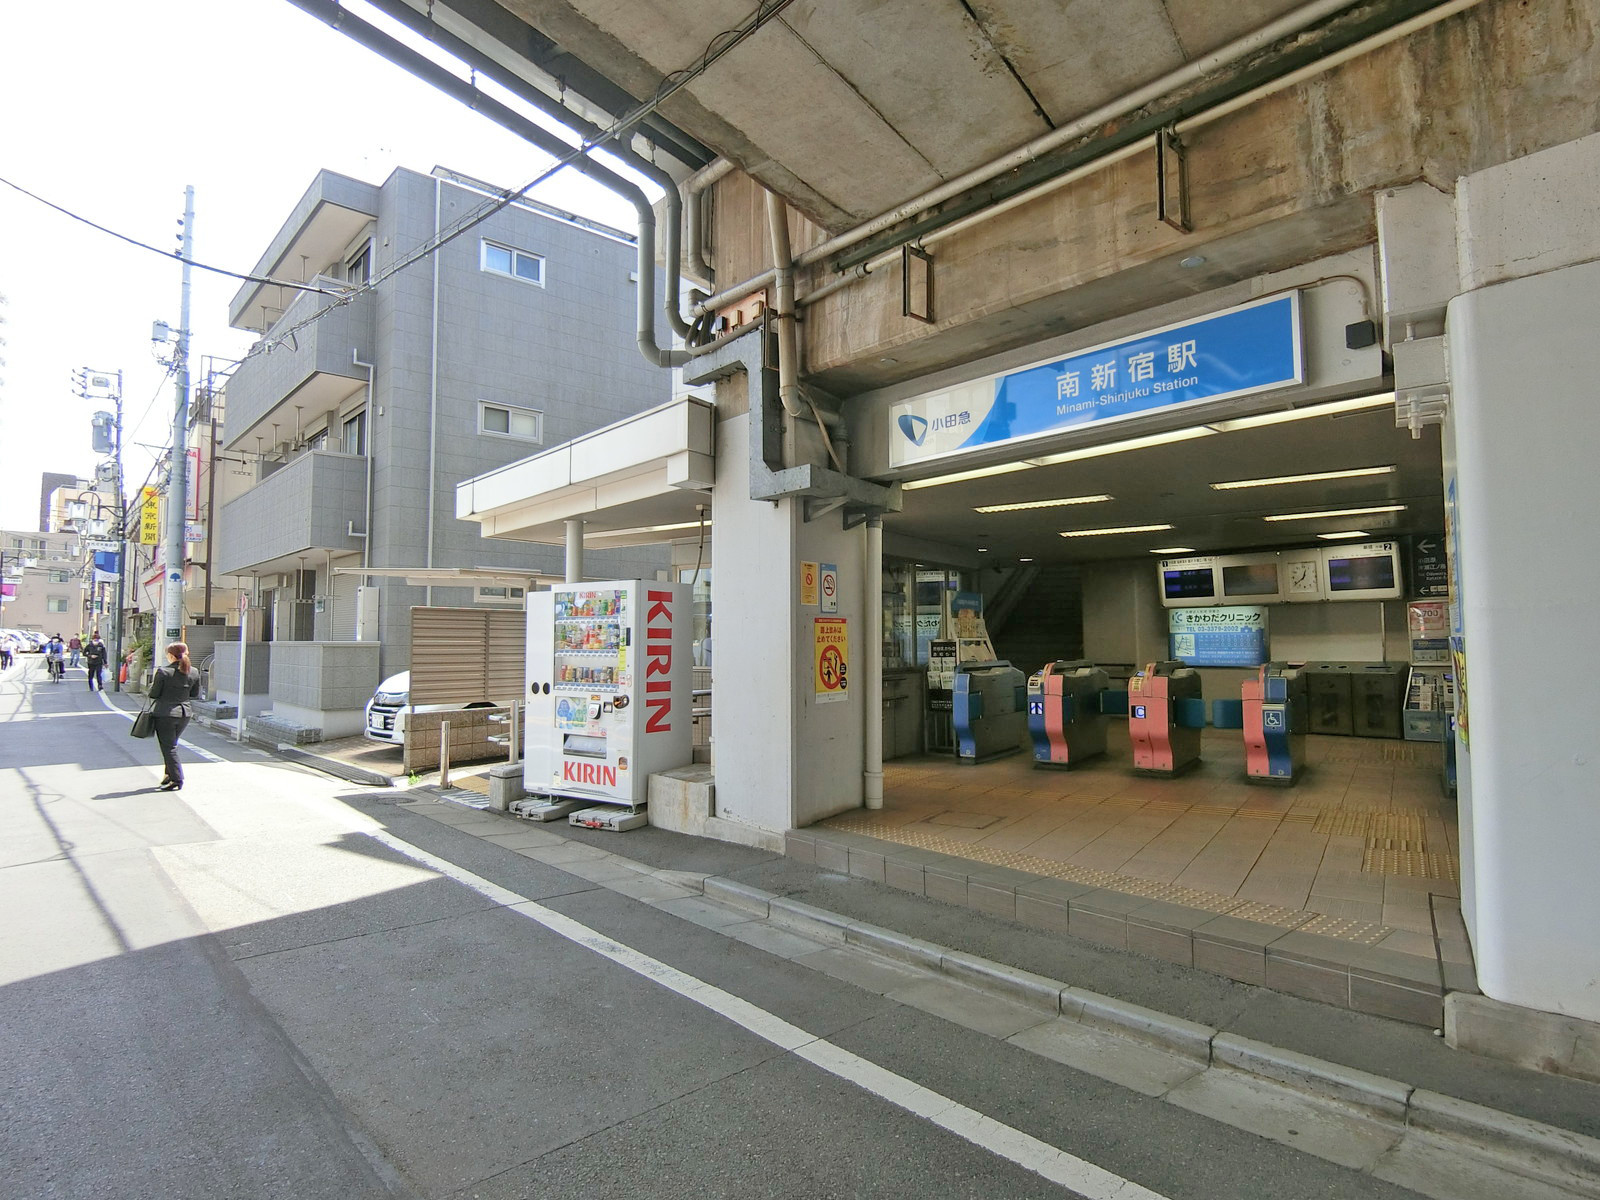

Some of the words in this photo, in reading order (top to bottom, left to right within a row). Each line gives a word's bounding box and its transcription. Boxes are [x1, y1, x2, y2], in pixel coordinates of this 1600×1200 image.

[1056, 339, 1197, 399] 南新宿駅
[1056, 387, 1150, 416] Minami-Shinjuku
[1153, 374, 1199, 394] Station
[931, 409, 972, 432] 小田急
[144, 500, 157, 542] 東京新聞
[1384, 543, 1392, 551] 2
[1186, 612, 1262, 623] きかわだクリニック
[817, 635, 846, 643] 止めてください
[645, 589, 673, 734] KIRIN
[563, 760, 617, 787] KIRIN
